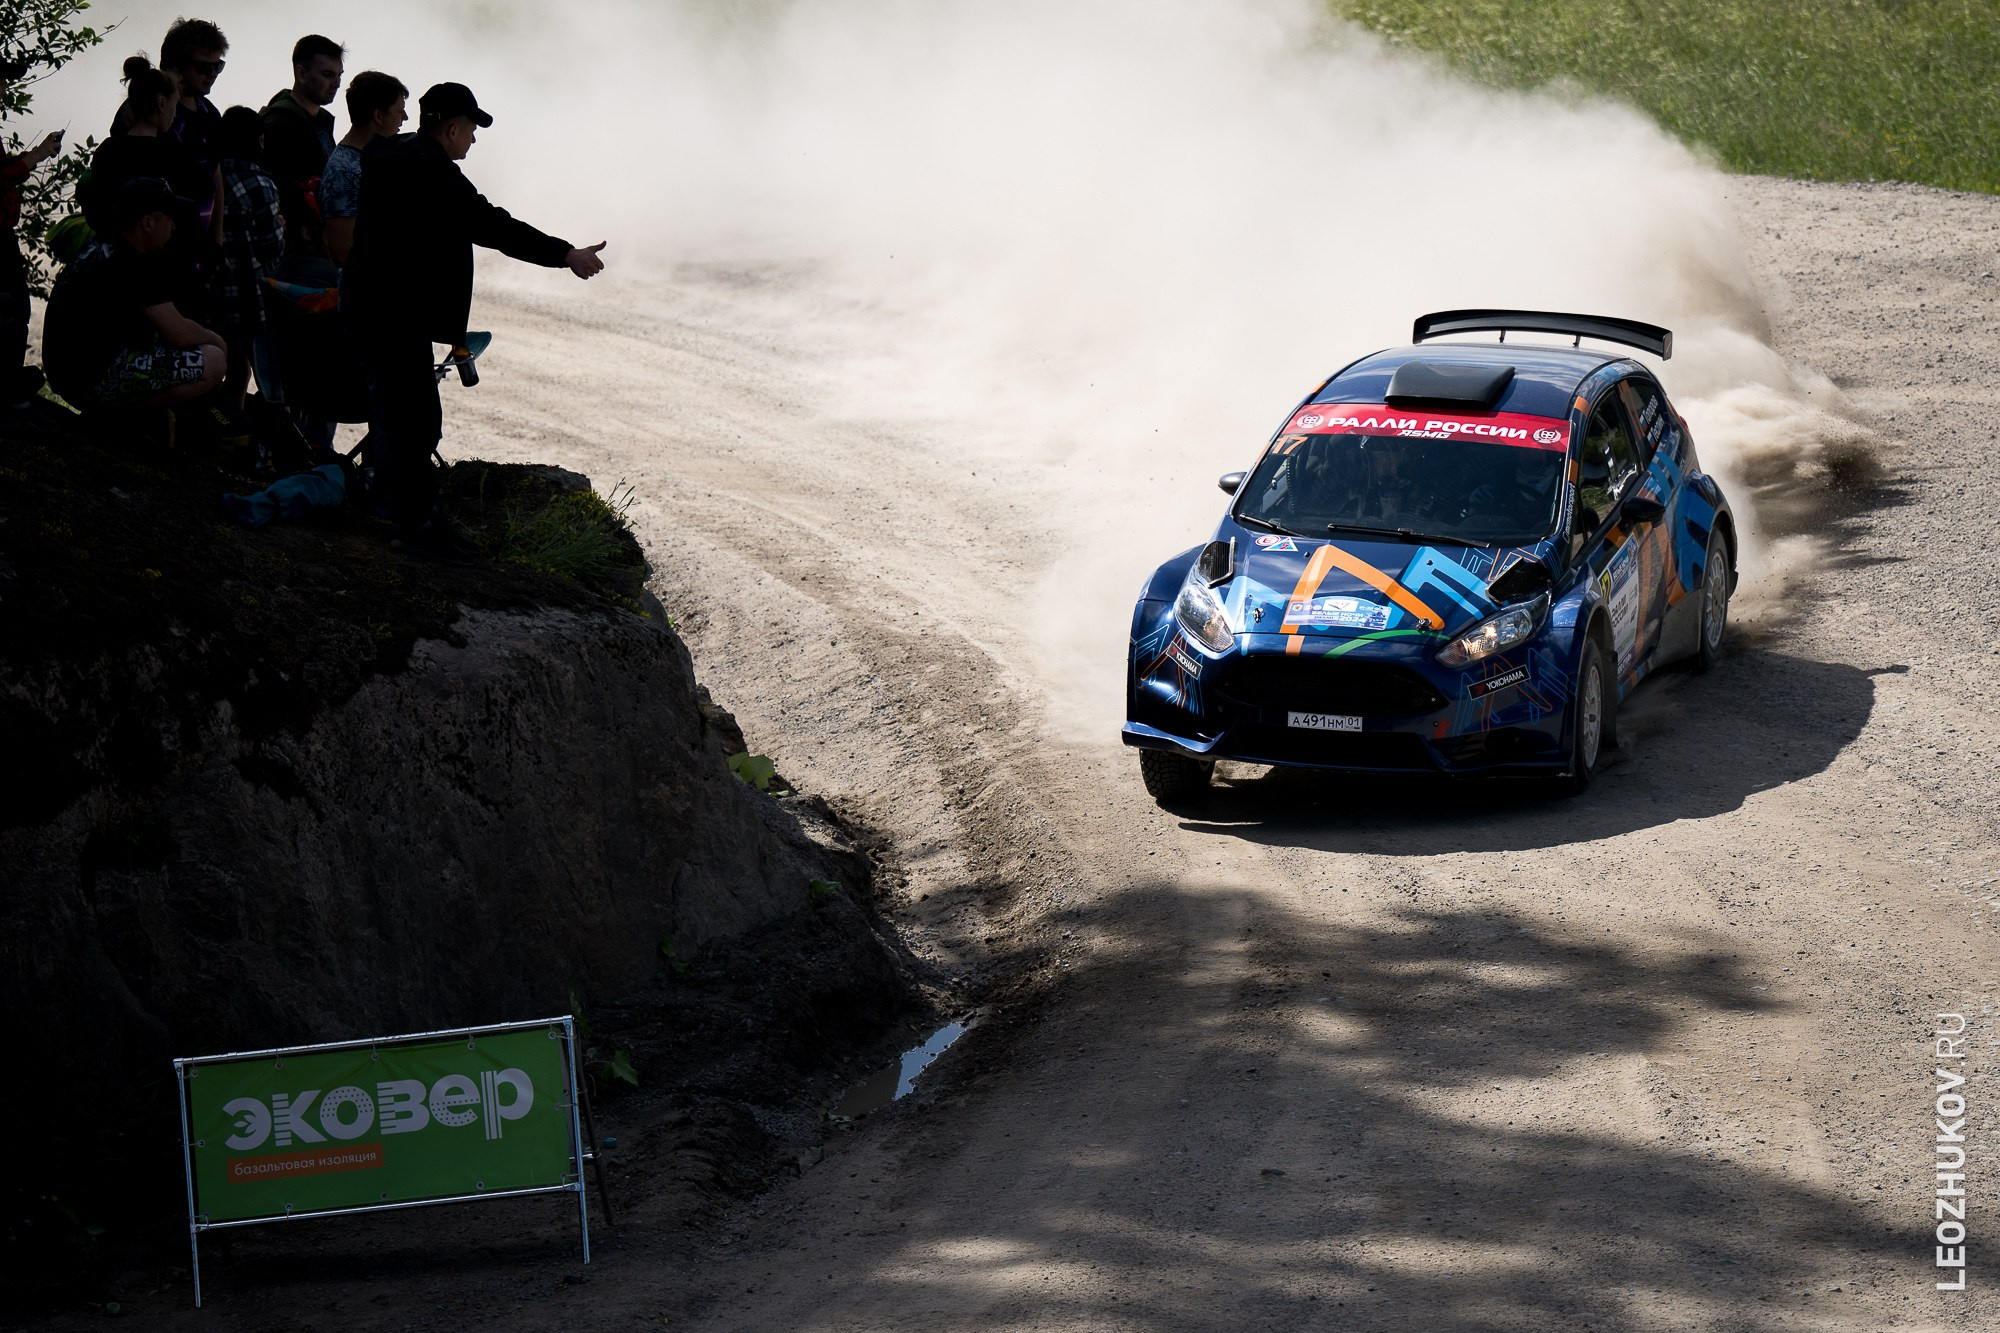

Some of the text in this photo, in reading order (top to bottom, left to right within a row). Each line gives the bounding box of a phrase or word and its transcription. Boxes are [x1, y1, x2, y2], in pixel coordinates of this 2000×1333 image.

[1327, 417, 1528, 440] РАЛЛИ РОССИИ
[1272, 436, 1309, 455] 17
[1486, 670, 1525, 690] YOKOHAMA
[234, 1150, 377, 1176] базальтовая изоляция
